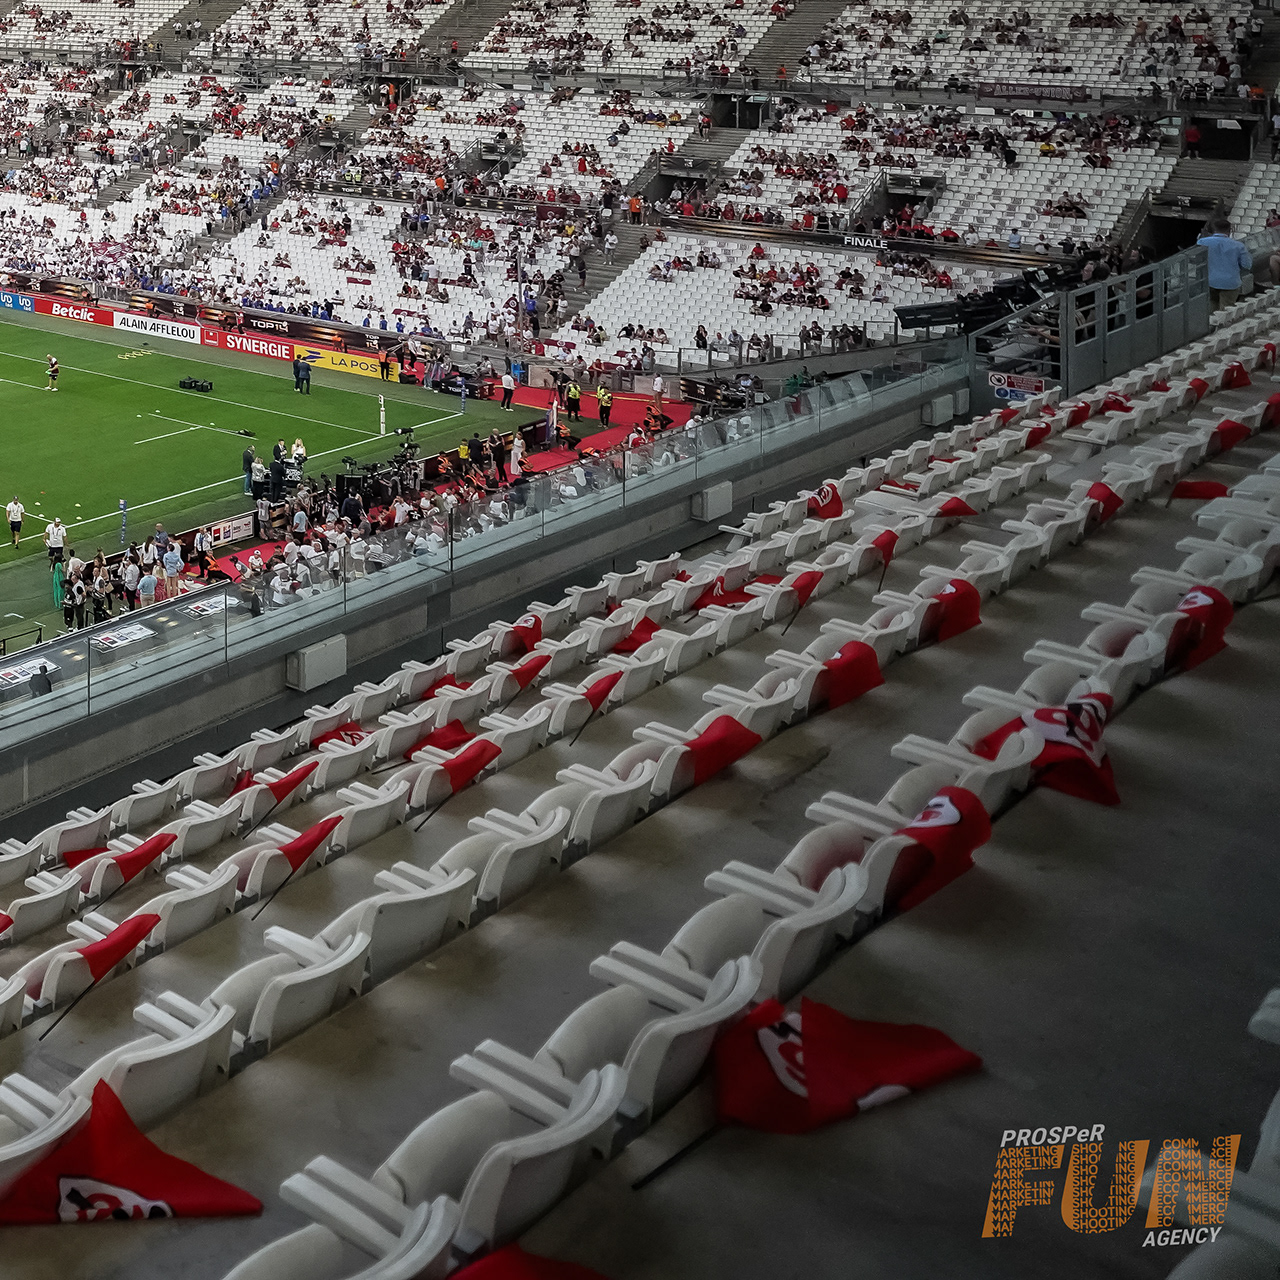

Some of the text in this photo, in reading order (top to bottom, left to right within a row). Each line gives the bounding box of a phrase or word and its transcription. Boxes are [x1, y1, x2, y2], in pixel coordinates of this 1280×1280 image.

[844, 237, 888, 249] FINALE
[52, 303, 95, 322] Betclic
[119, 317, 195, 339] ALAIN AFFLELOU
[227, 335, 290, 359] SYNERGIE
[331, 356, 348, 368] LA
